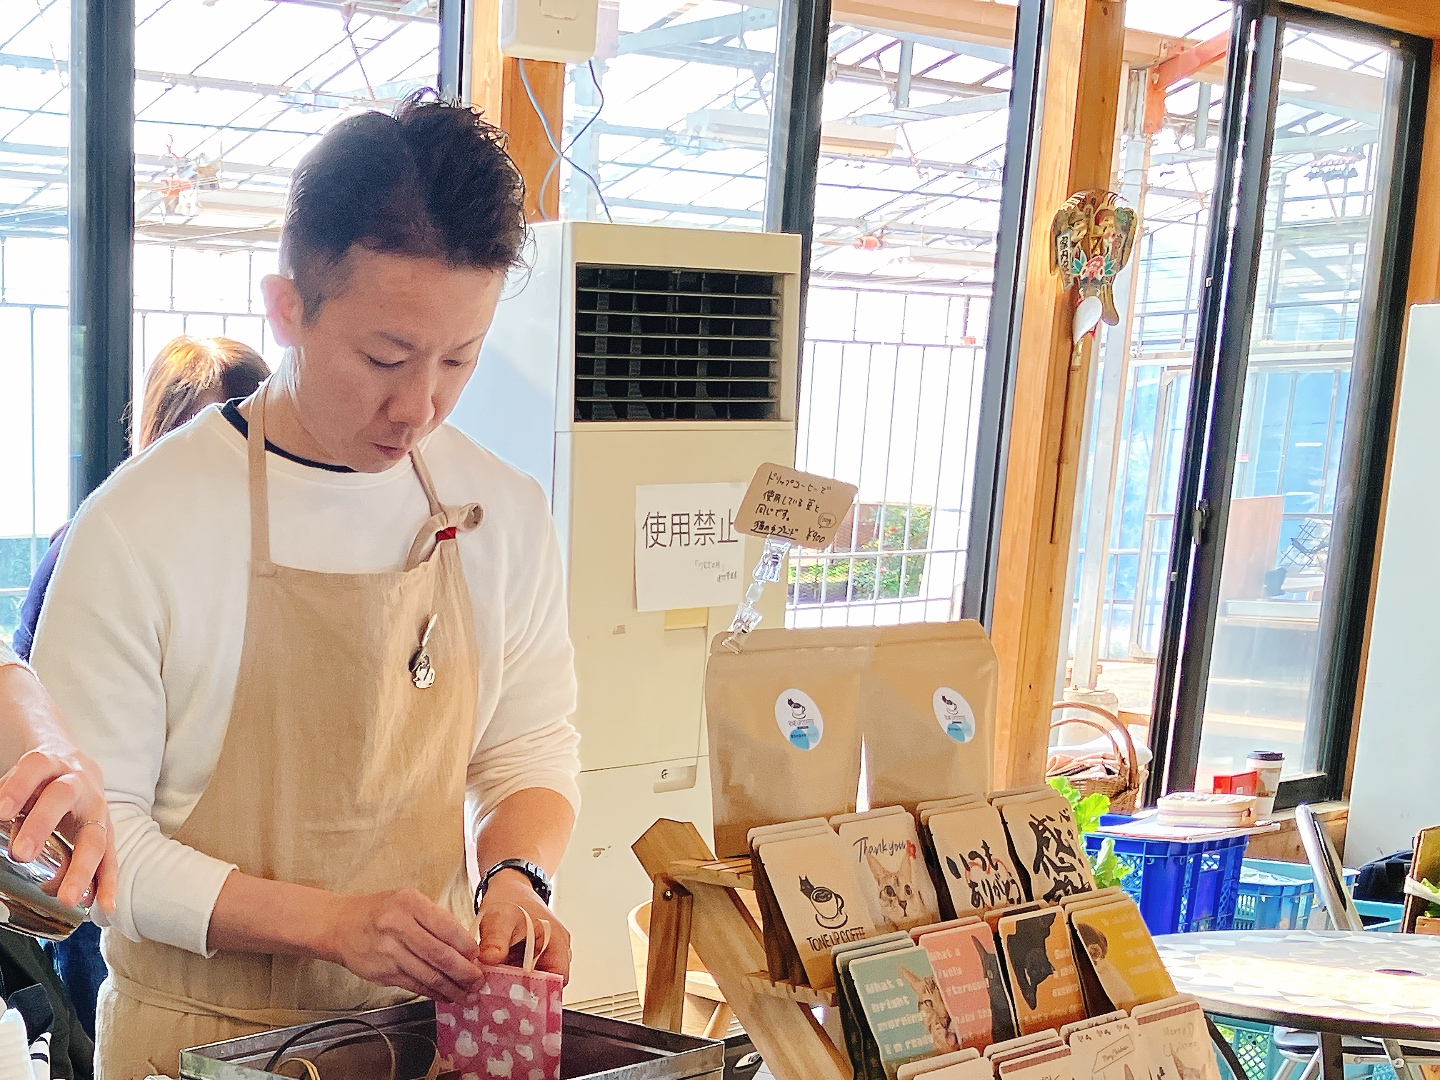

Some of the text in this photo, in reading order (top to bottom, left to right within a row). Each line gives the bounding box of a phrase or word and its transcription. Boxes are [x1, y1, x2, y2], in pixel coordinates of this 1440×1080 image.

[642, 508, 738, 549] 使用禁止
[853, 837, 888, 862] Thank
[946, 839, 998, 879] いつも
[968, 872, 1022, 908] ありがとう
[807, 934, 831, 951] TONE
